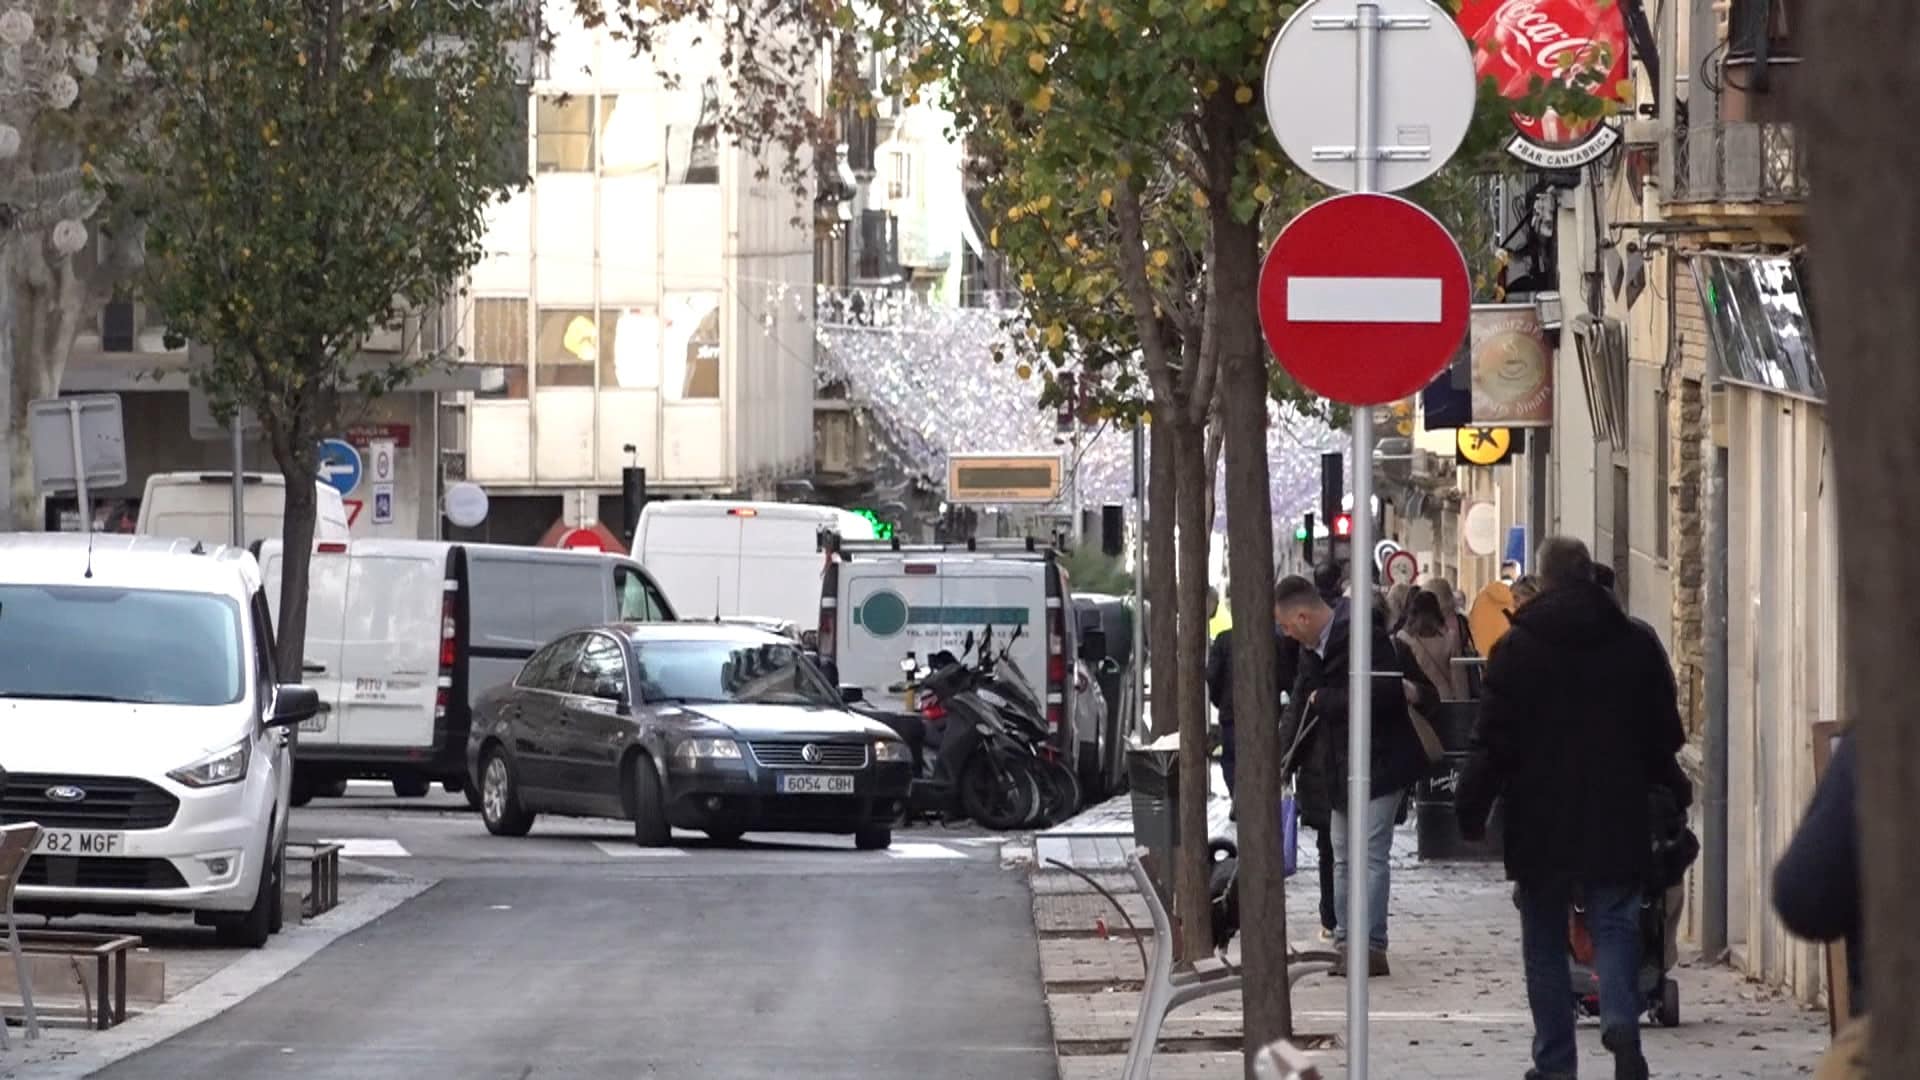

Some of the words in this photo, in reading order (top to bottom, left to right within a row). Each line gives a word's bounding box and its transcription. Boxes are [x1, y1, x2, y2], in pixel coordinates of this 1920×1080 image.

[1520, 145, 1543, 162] BAR
[1547, 138, 1607, 165] CANTABRIC
[788, 776, 821, 790] 6054
[80, 834, 119, 852] MGF
